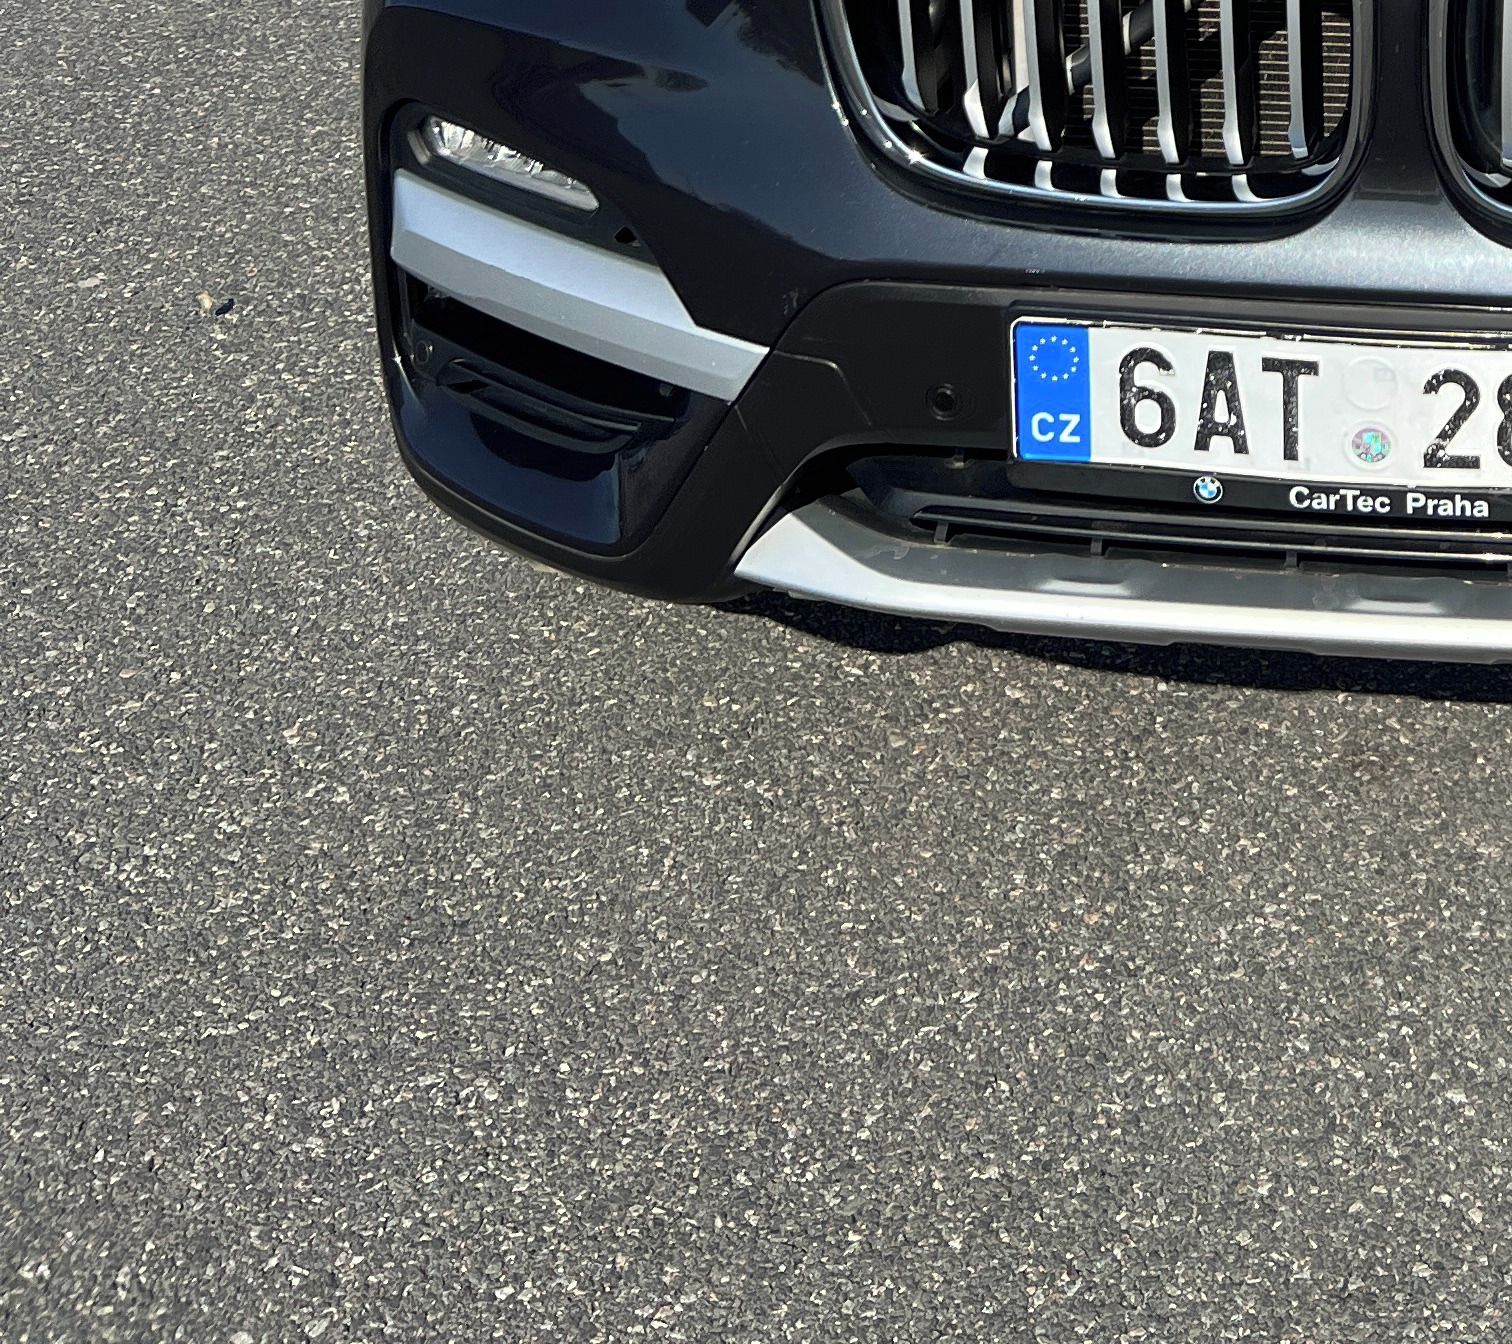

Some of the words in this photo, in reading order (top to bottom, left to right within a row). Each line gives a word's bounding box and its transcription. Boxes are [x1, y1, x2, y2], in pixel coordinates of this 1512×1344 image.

[1118, 346, 1321, 462] 6AT
[1030, 411, 1081, 444] CZ
[1288, 485, 1391, 514] CarTec
[1405, 491, 1490, 518] Praha
